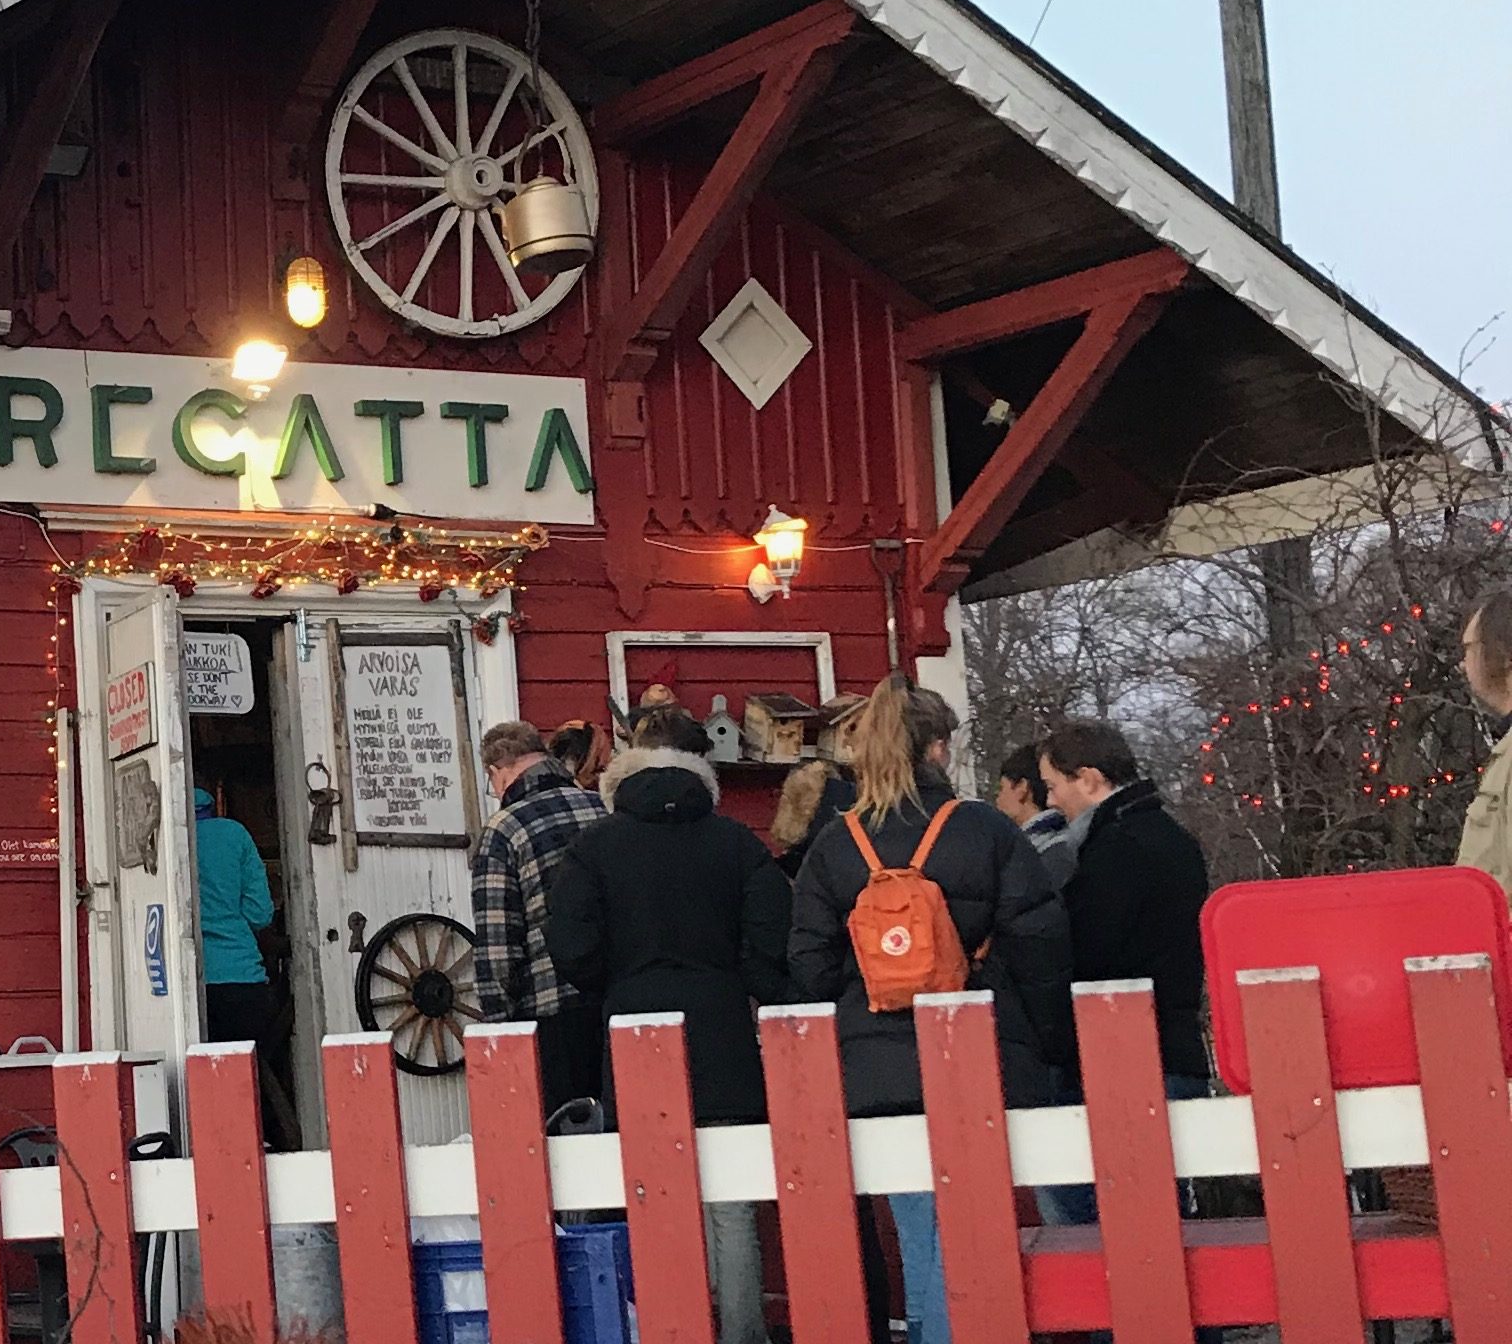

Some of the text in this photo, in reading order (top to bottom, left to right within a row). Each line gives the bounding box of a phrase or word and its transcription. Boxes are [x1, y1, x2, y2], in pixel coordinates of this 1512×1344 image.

[185, 656, 229, 671] UKKOA
[358, 650, 423, 675] ARVOISA
[198, 683, 218, 695] THE
[368, 676, 420, 698] VARAS
[406, 708, 423, 720] OLE
